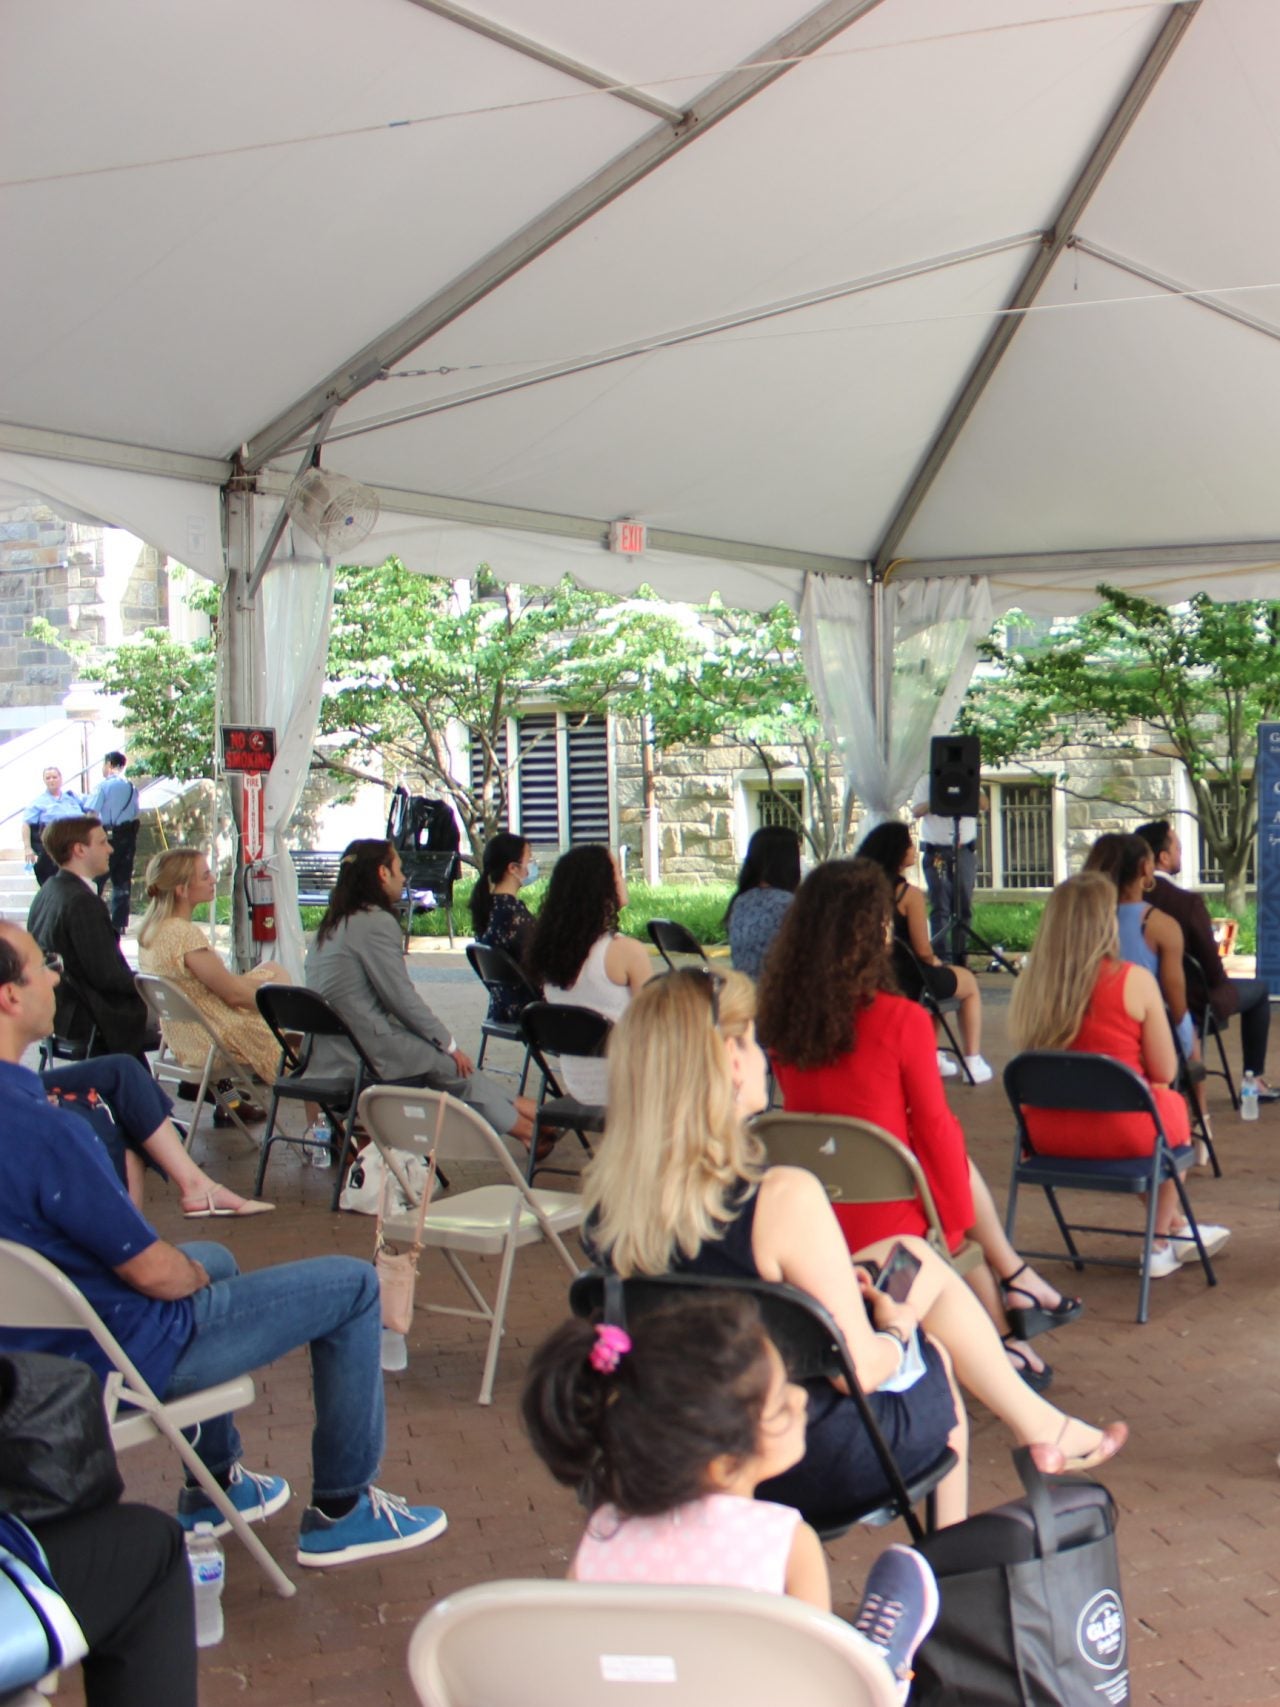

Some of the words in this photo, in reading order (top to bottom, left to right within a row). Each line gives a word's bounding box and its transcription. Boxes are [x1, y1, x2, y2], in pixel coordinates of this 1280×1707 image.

[622, 525, 643, 551] EXIT
[231, 731, 245, 749] NO
[226, 751, 271, 769] SMOKING
[246, 778, 260, 788] FIRE
